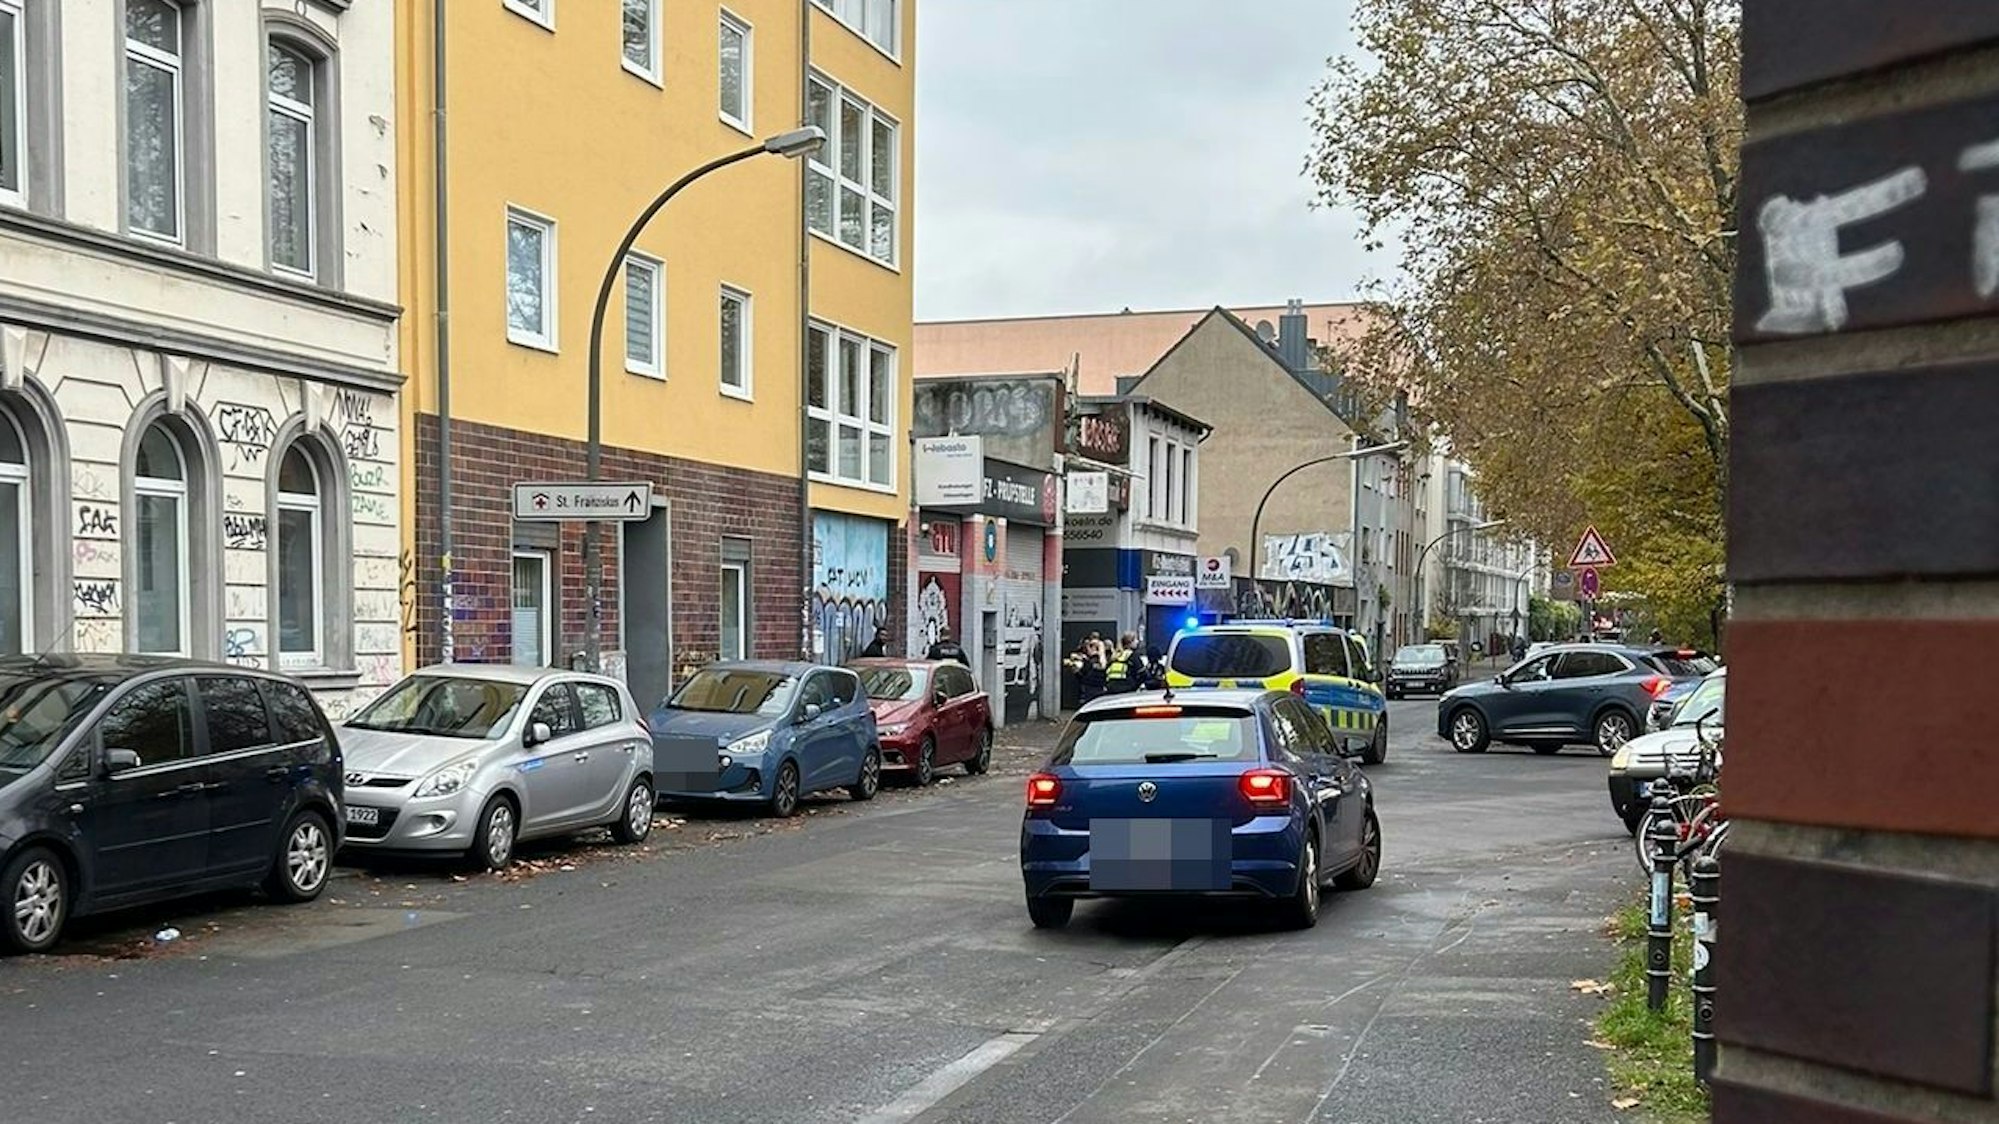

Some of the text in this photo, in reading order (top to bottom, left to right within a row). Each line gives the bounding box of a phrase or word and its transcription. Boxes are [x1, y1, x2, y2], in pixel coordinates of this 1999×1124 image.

[556, 494, 619, 509] St. Franziskus
[1151, 580, 1190, 588] EINGANG
[350, 809, 377, 821] 1922
